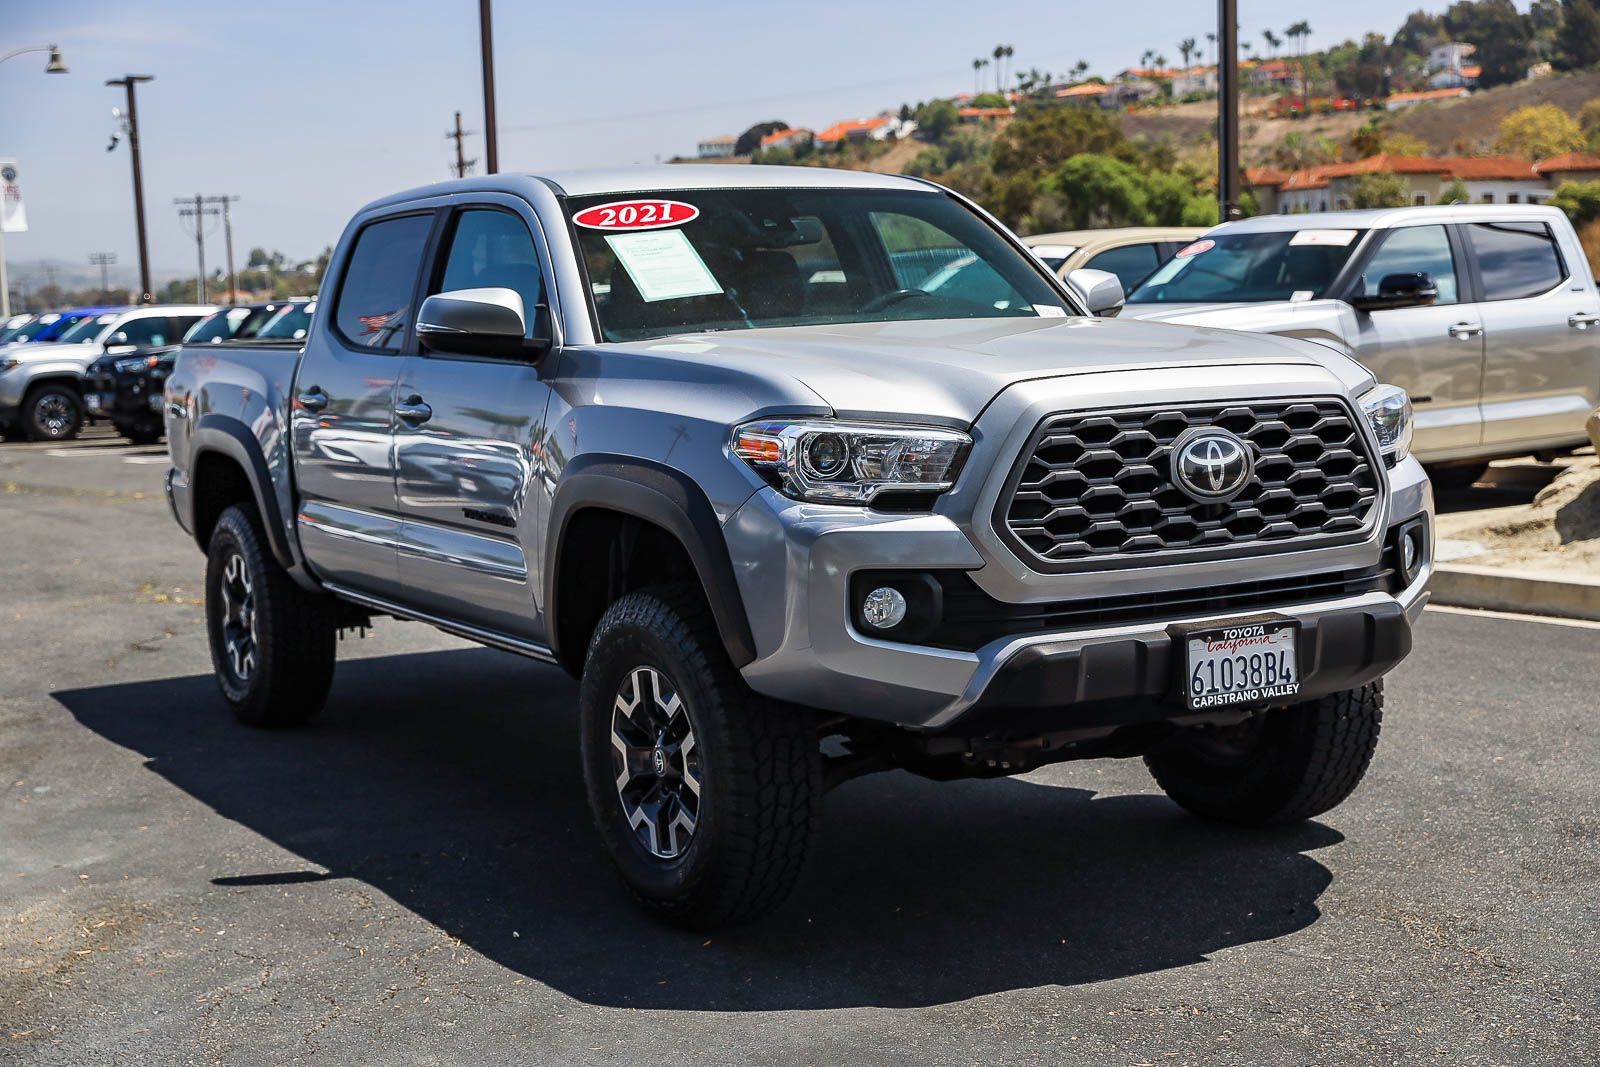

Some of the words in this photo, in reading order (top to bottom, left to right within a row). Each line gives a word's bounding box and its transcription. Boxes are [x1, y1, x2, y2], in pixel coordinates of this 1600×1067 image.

[599, 203, 673, 226] 2021
[1207, 635, 1277, 654] California
[1222, 626, 1265, 640] TOYOTA
[1191, 650, 1292, 695] 61038B4
[1192, 690, 1259, 708] CAPISTRANO
[1261, 683, 1300, 697] VALLEY
